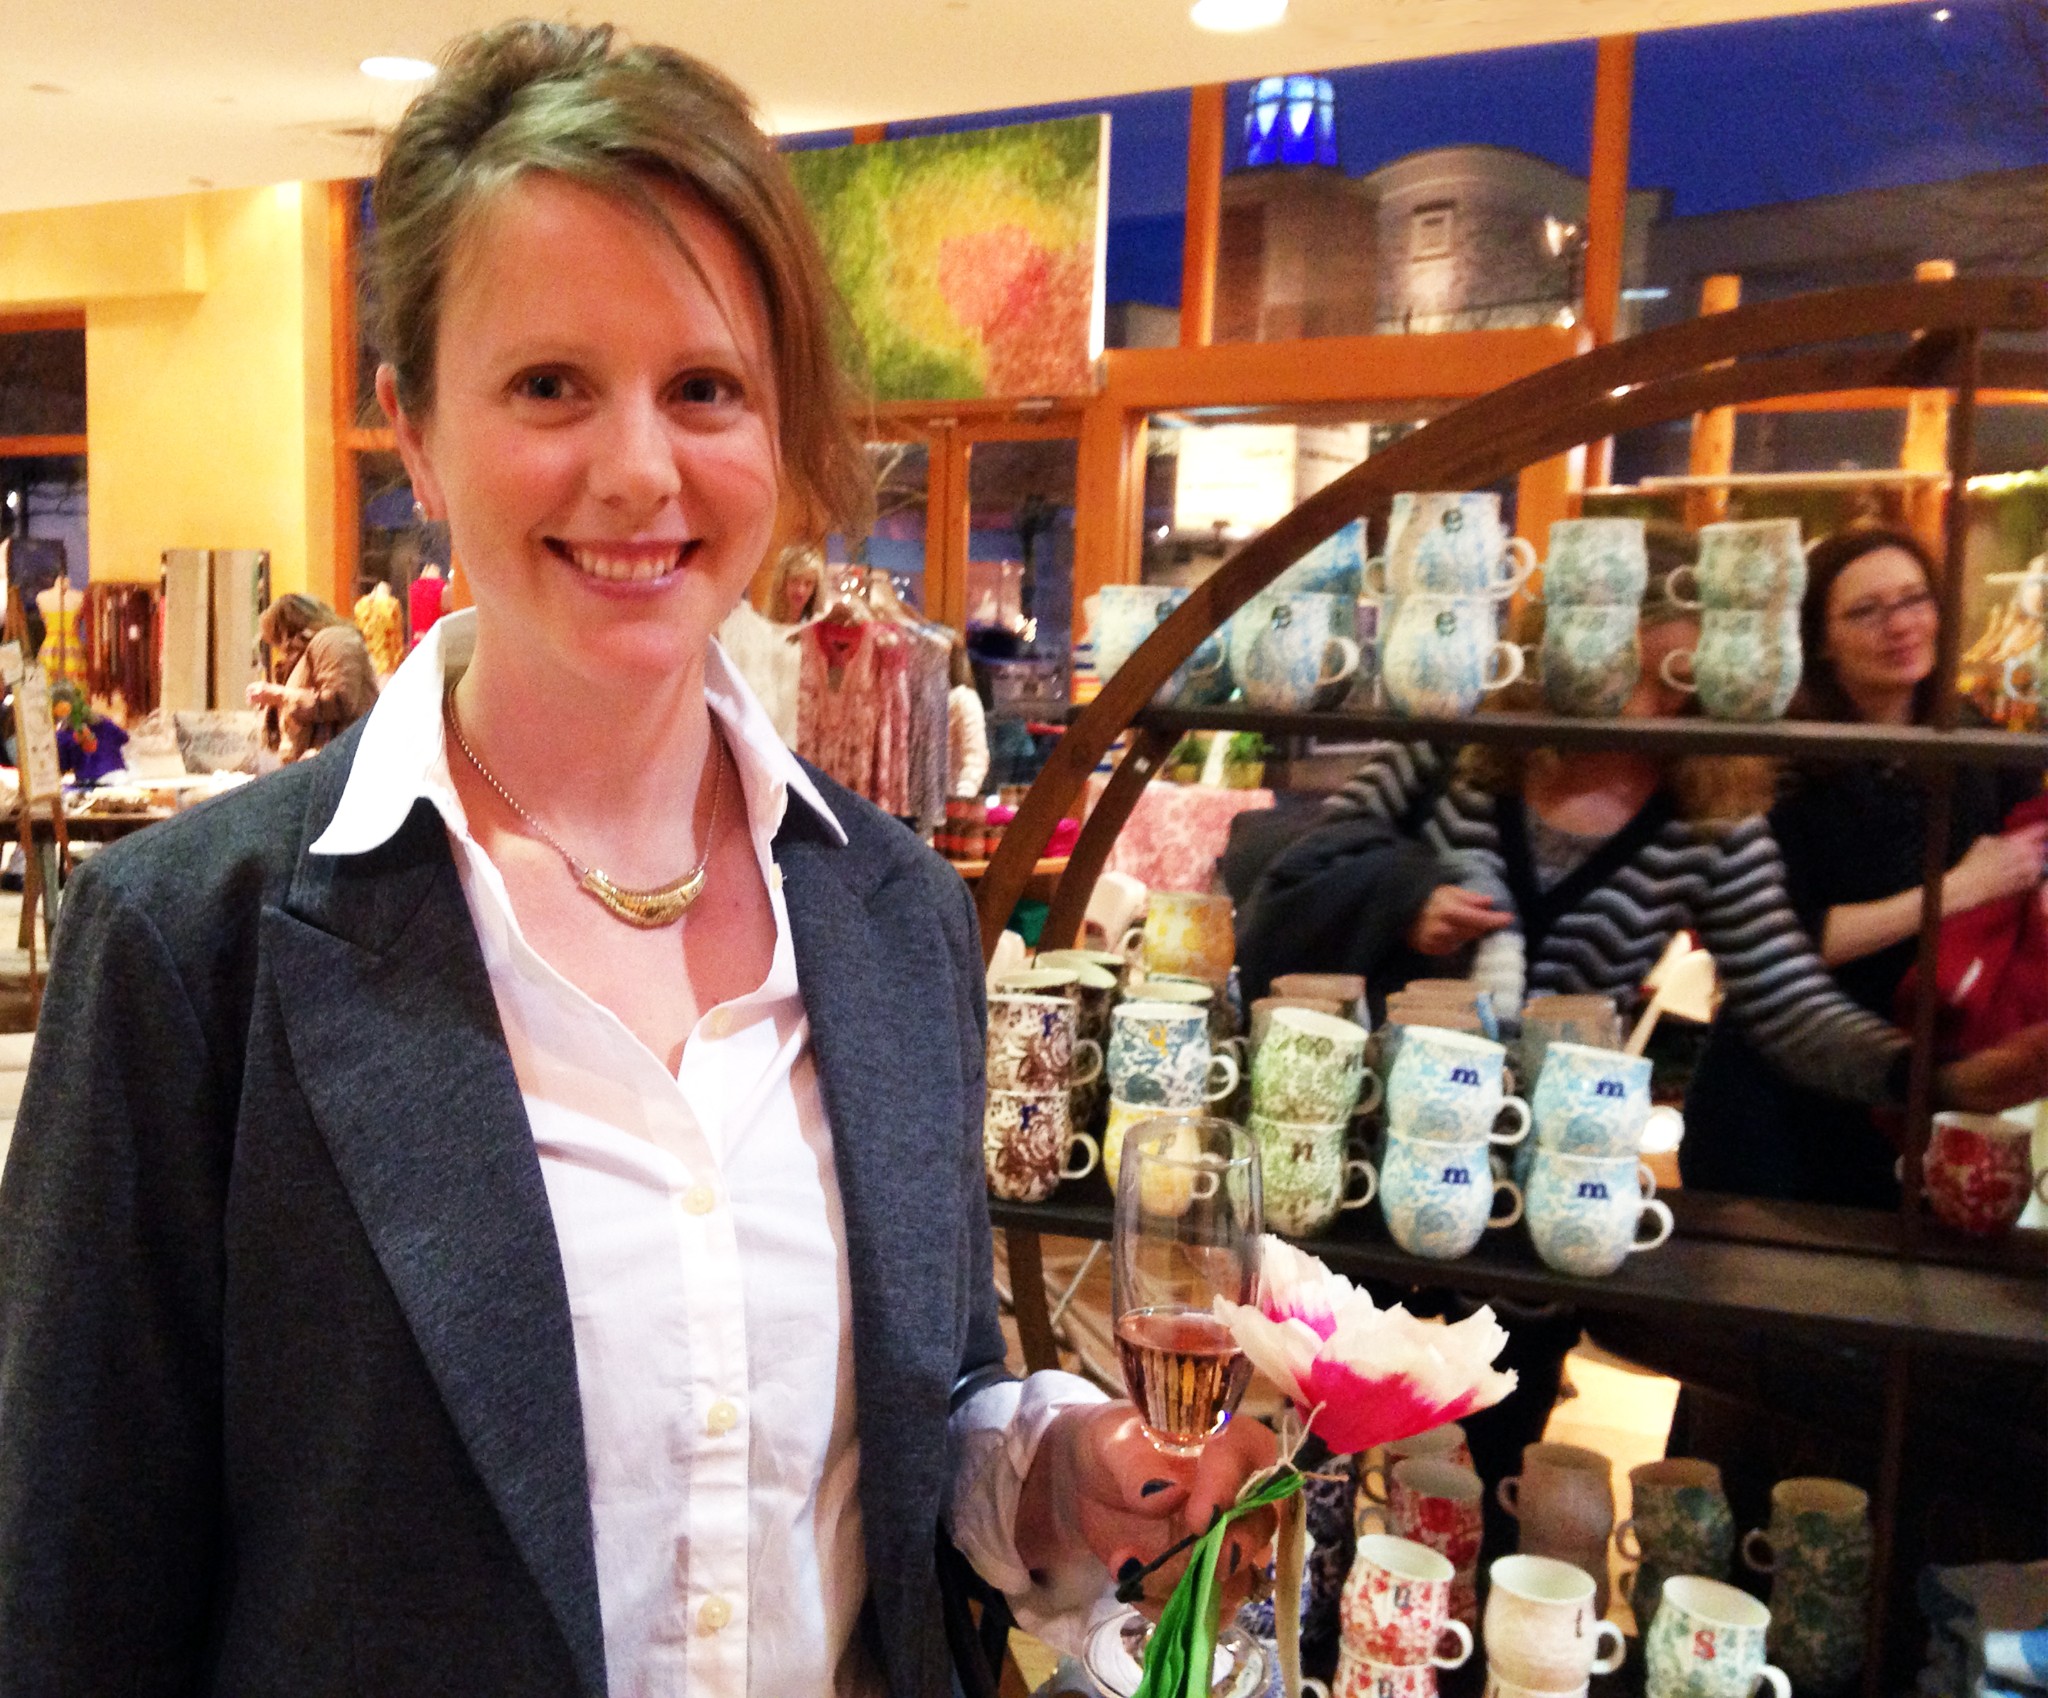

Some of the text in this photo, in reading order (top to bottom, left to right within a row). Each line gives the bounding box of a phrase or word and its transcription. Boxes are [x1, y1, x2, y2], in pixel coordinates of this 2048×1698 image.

[1450, 1067, 1481, 1086] m
[1595, 1079, 1625, 1098] m
[1441, 1166, 1471, 1185] m
[1577, 1181, 1608, 1200] m
